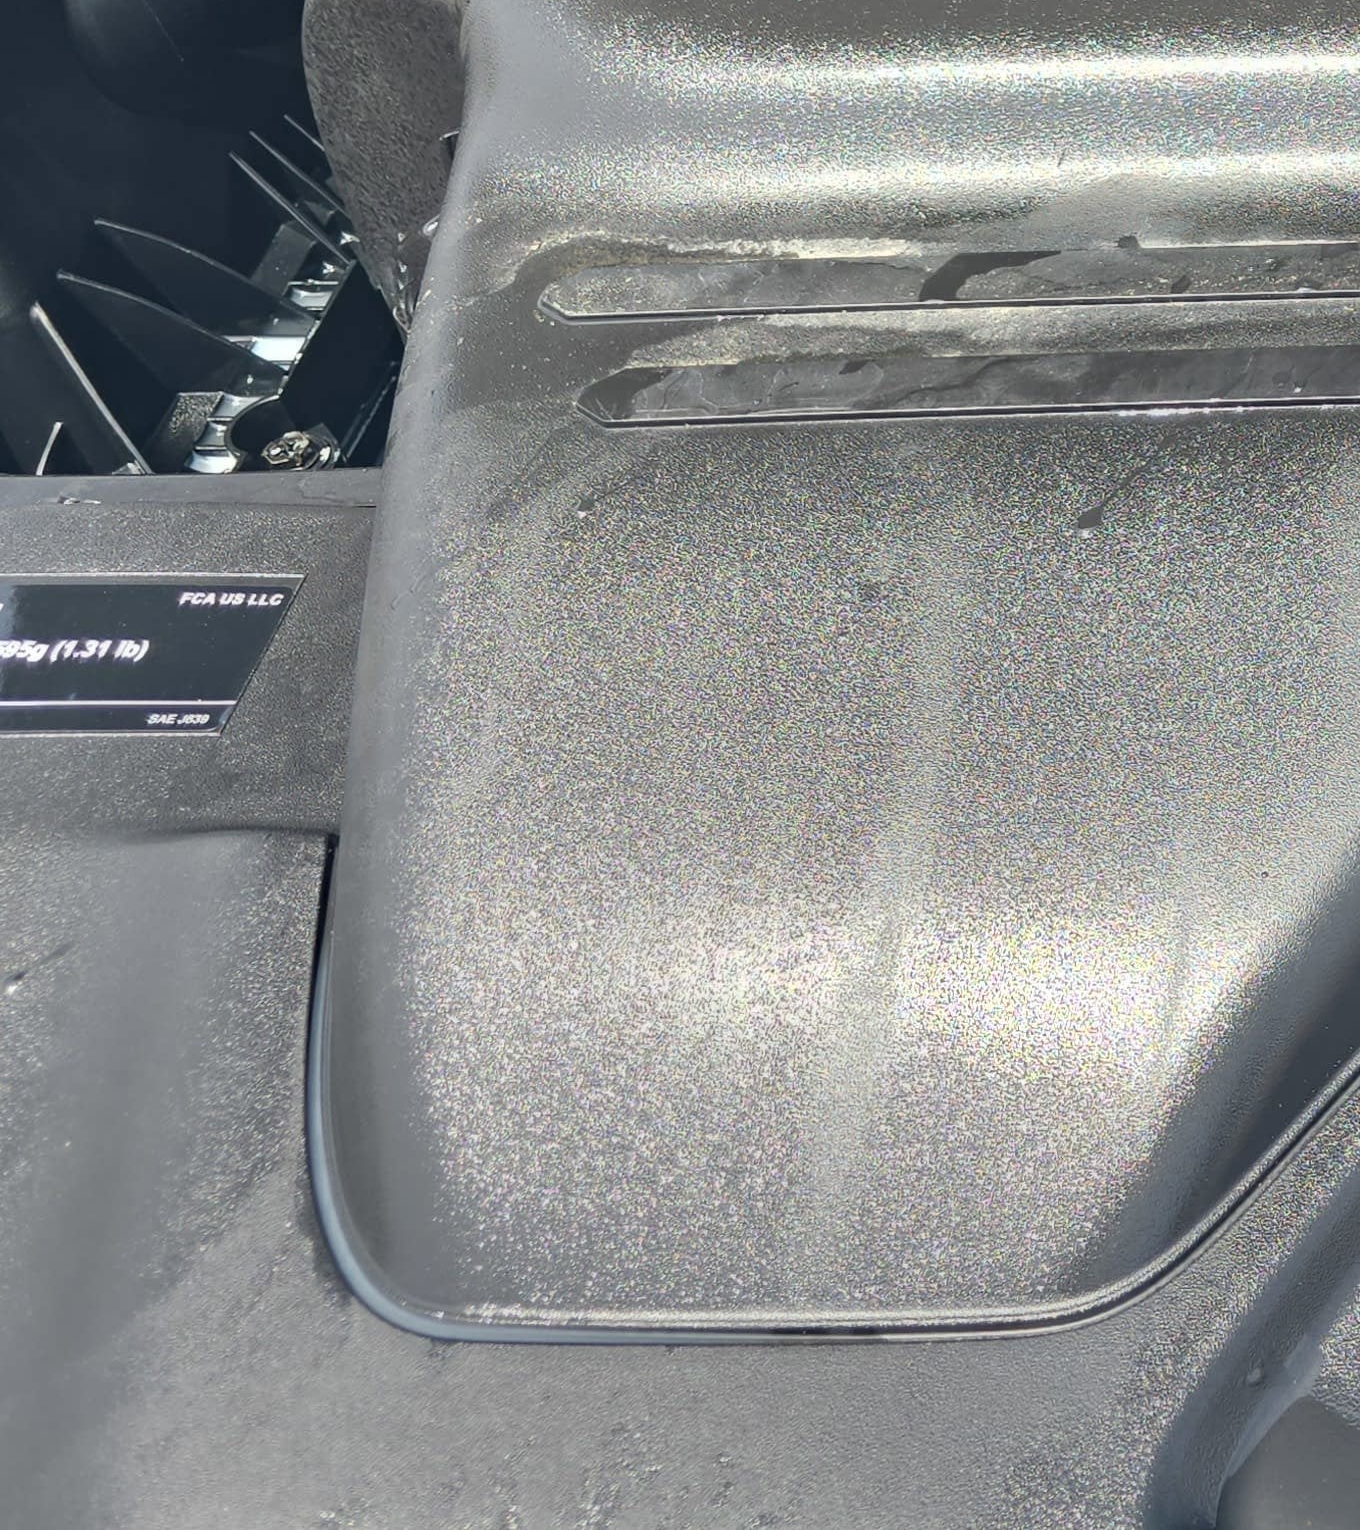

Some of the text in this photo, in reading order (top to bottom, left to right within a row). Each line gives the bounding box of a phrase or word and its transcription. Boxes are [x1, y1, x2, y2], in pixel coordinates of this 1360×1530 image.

[178, 591, 284, 606] FCA US LLC
[50, 638, 111, 662] (1.31
[113, 639, 150, 662] lb)
[146, 713, 177, 725] SAE
